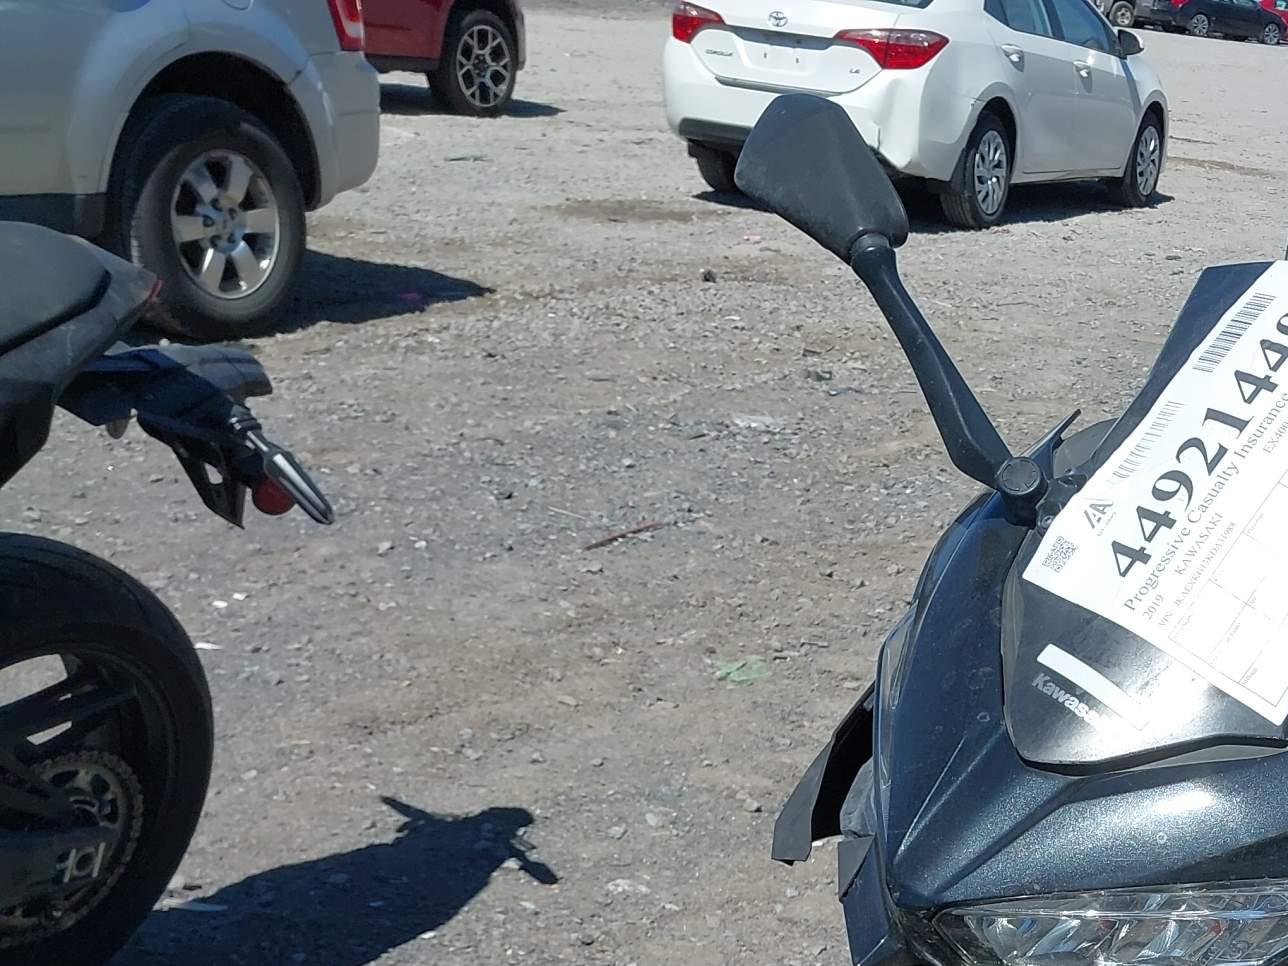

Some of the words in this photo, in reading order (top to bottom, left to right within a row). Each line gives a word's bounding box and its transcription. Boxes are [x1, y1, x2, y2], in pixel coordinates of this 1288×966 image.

[1122, 526, 1192, 613] Progressive
[1186, 461, 1240, 524] Casualty
[1141, 593, 1165, 621] 2019
[1172, 510, 1224, 576] KAWASAKI
